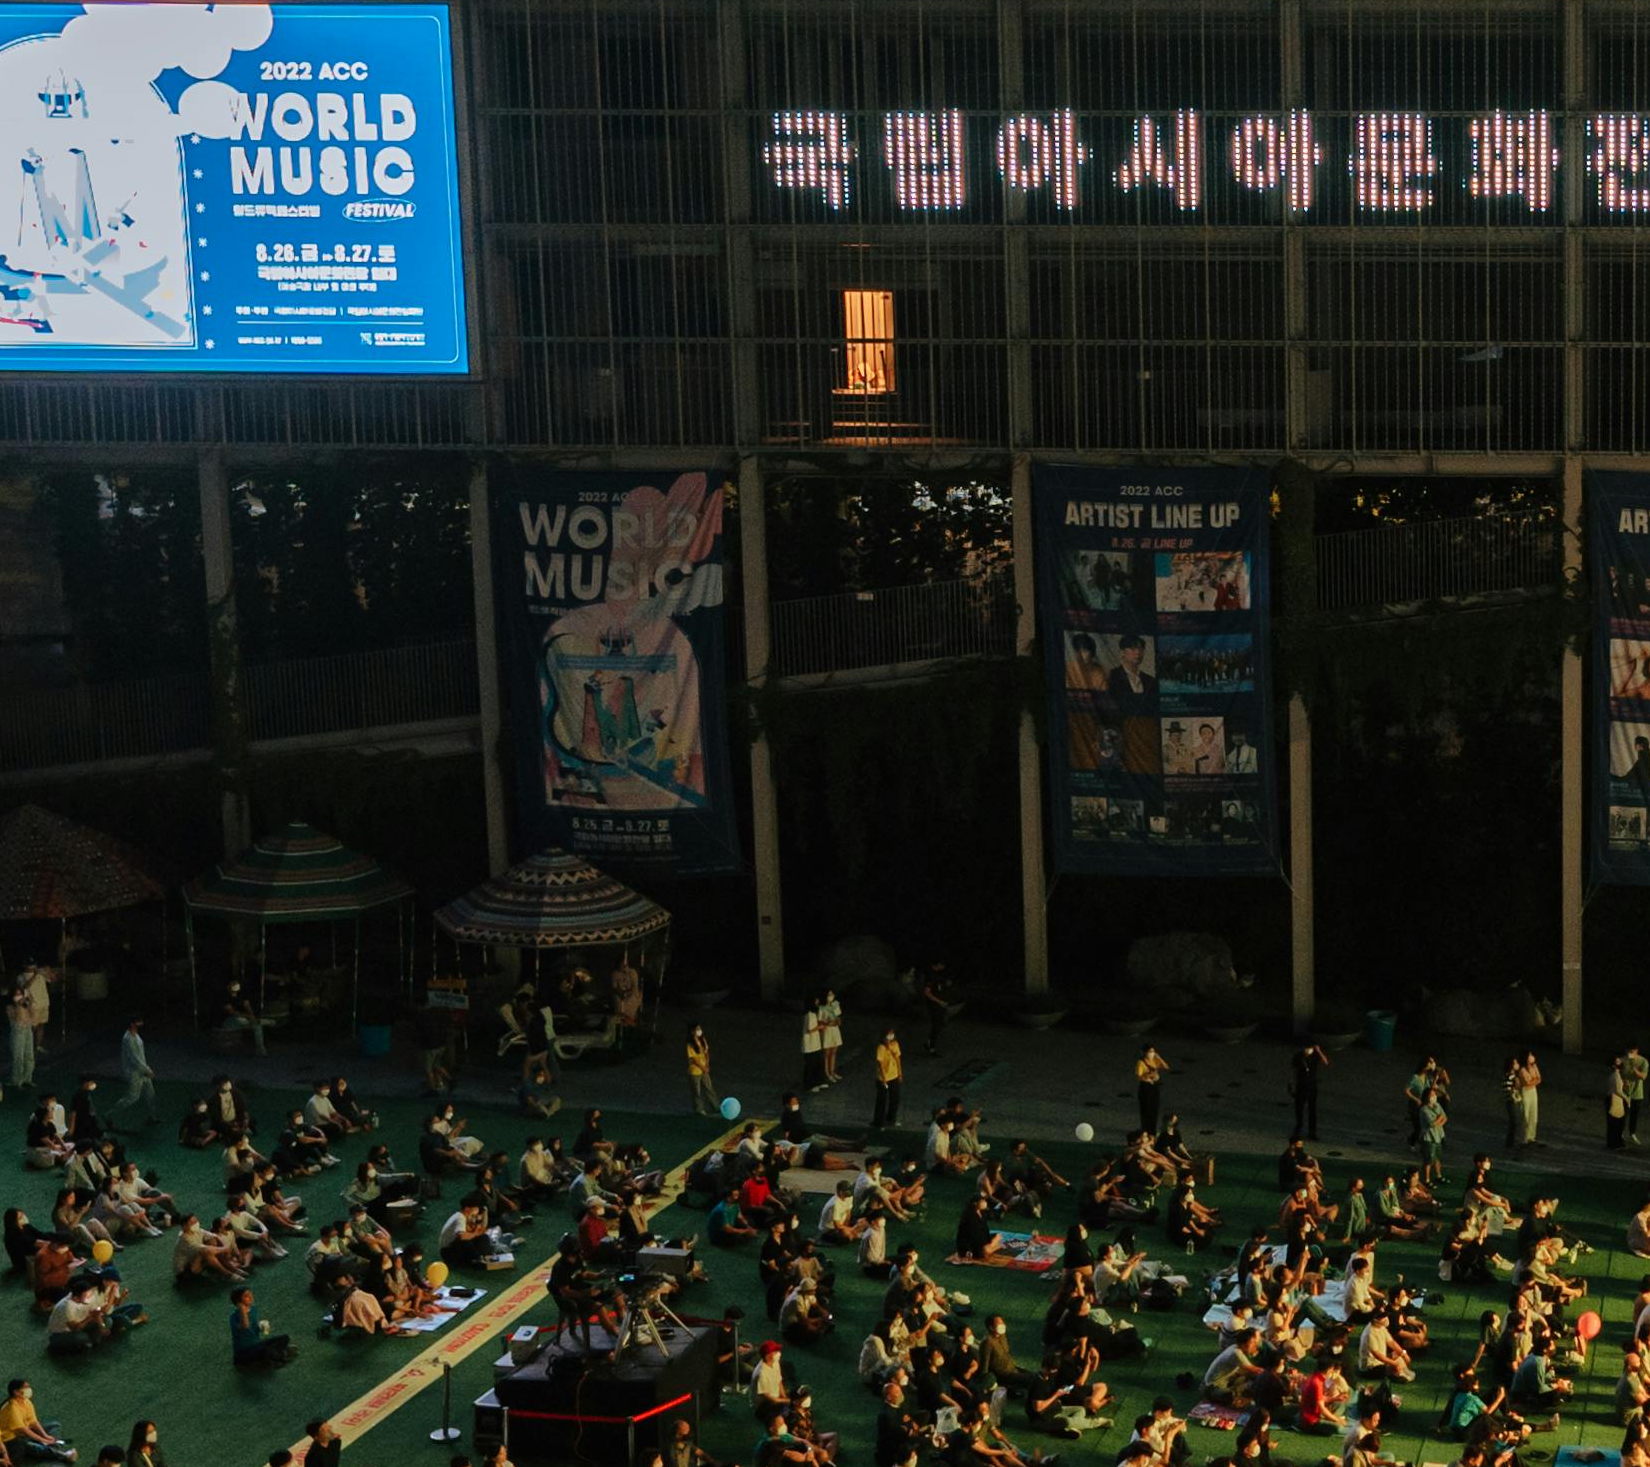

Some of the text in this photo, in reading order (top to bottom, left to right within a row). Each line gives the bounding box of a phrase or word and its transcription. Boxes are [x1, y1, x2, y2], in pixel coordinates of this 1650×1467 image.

[260, 61, 368, 80] 2022 ACC
[229, 92, 416, 141] WORLD
[230, 146, 415, 195] MUSIC
[345, 203, 415, 218] FESTIVAL
[578, 491, 629, 502] 2022 AC
[1120, 485, 1184, 496] 2022 ACC
[518, 501, 698, 550] WORLD
[1064, 501, 1240, 529] ARTIST LINE UP
[524, 550, 693, 601] MUSIC
